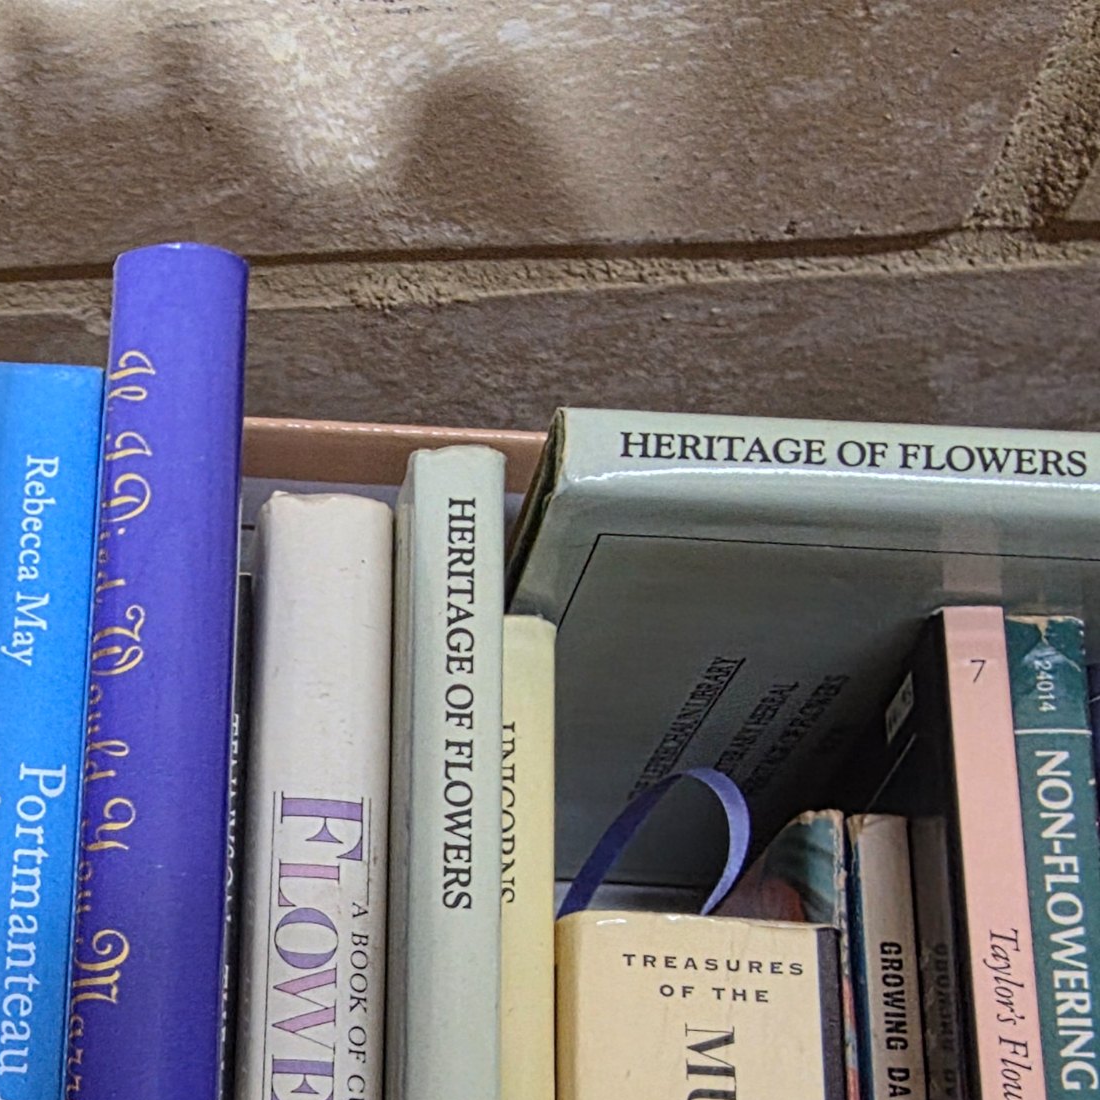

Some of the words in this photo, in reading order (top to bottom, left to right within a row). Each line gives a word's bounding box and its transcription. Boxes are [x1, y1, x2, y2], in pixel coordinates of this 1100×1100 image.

[620, 431, 827, 464] HERITAGE
[837, 440, 889, 468] OF
[898, 442, 1088, 477] FLOWERS
[17, 454, 59, 583] Rebecca
[445, 497, 476, 675] HERITAGE
[0, 591, 50, 667] May
[444, 683, 474, 731] OF
[970, 659, 987, 684] 7
[1033, 659, 1058, 712] 24014
[442, 738, 473, 911] FLOWERS
[0, 762, 67, 1076] Portmanteau
[352, 901, 368, 919] A
[1034, 750, 1099, 1092] NON-FLOWERING
[349, 931, 369, 1014] BOOK
[622, 953, 804, 976] TREASURES
[659, 984, 694, 999] OF
[712, 987, 769, 1003] THE
[879, 941, 909, 1051] GROWING
[982, 928, 1024, 1026] Taylor's
[348, 1025, 366, 1064] OF
